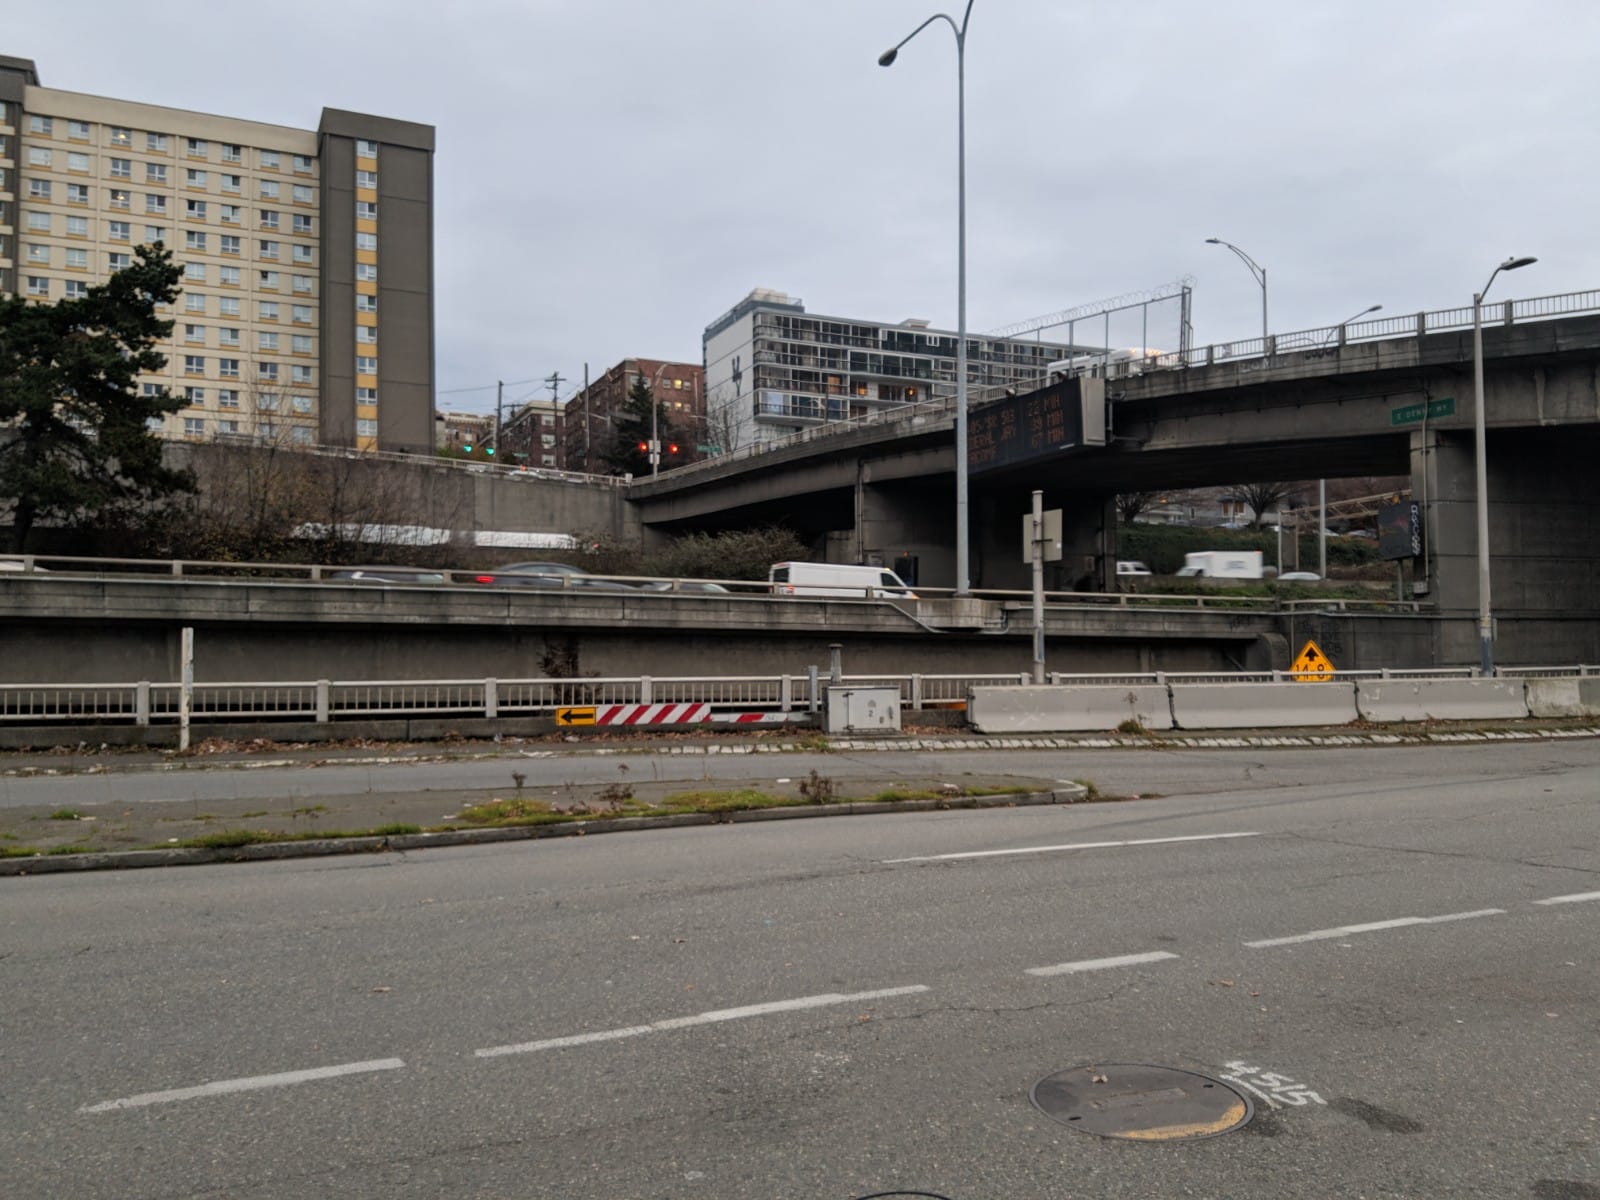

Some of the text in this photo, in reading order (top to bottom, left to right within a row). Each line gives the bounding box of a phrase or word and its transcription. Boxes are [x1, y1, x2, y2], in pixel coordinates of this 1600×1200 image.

[1044, 393, 1060, 411] MIN
[1047, 409, 1064, 427] MIN
[1047, 427, 1064, 444] MIN
